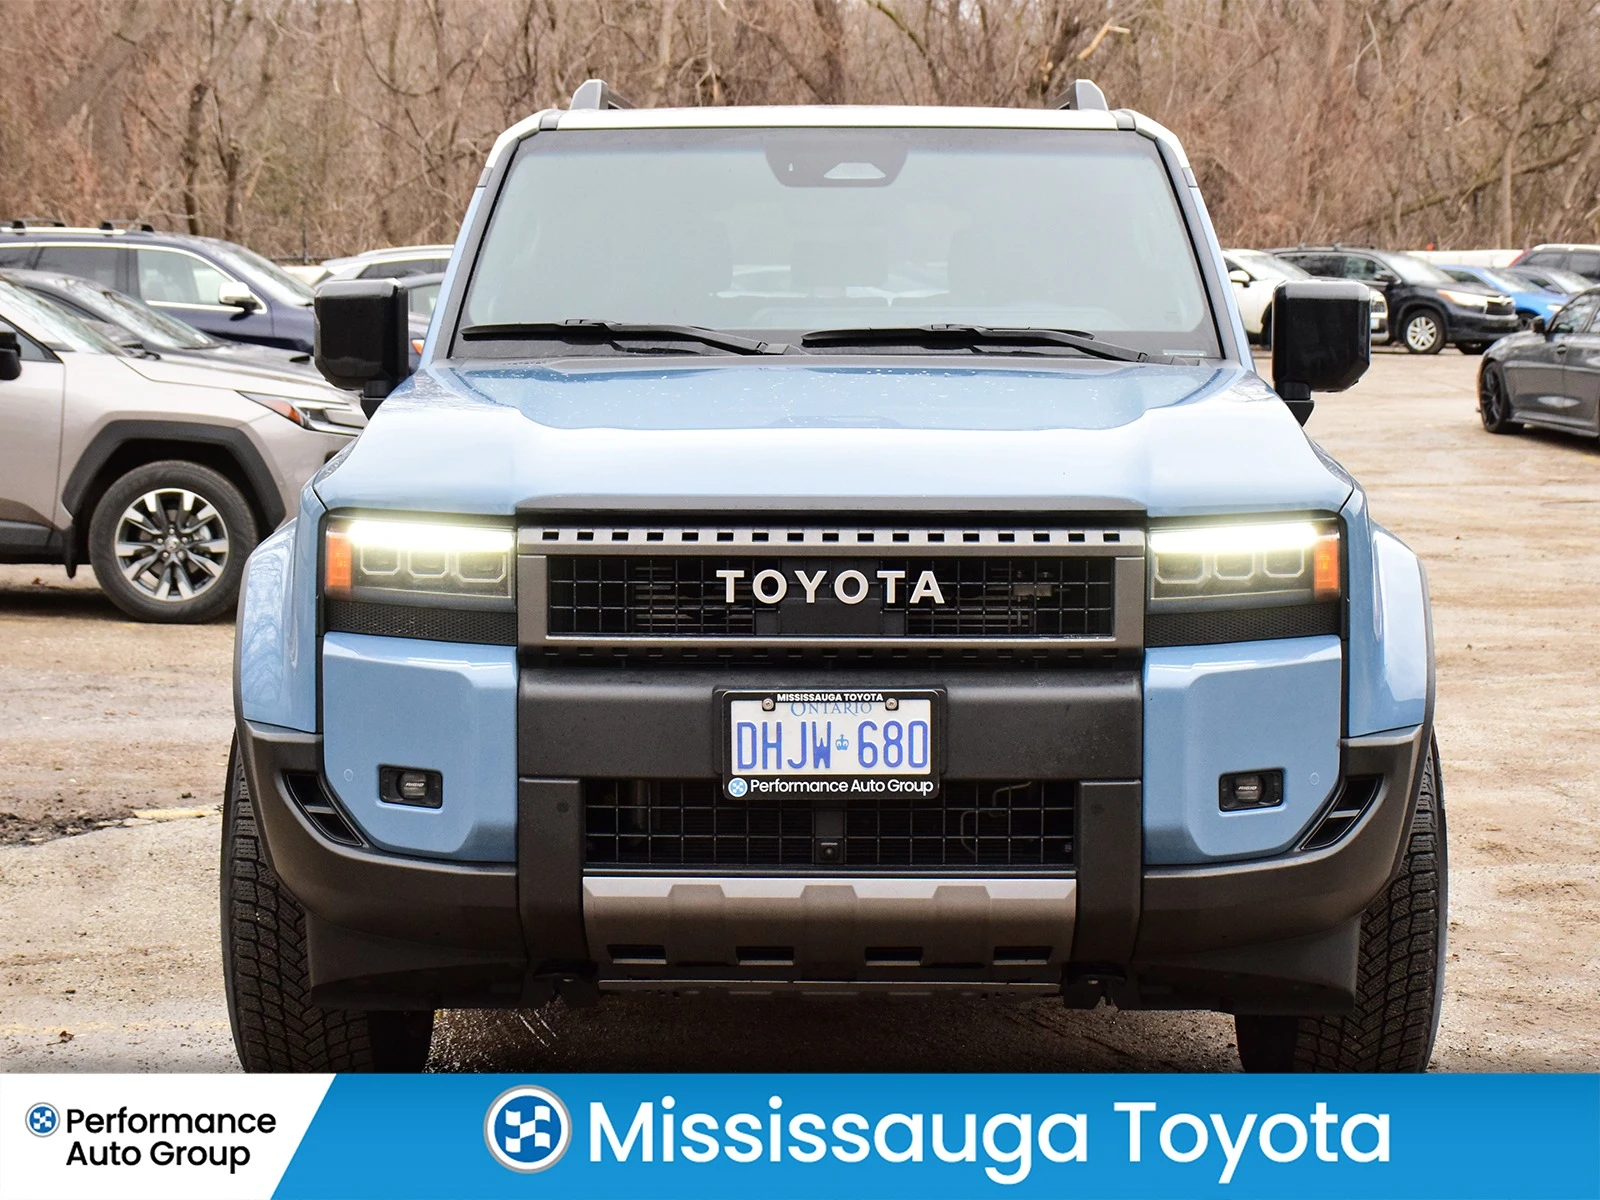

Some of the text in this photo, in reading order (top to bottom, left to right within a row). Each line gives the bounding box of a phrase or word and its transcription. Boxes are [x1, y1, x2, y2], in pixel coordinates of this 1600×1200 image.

[716, 569, 945, 604] TOYOTA
[776, 693, 884, 702] MISSISSAUGA TOYOTA
[790, 702, 873, 716] ONTARIO
[737, 720, 928, 769] DHJW 680
[750, 778, 934, 797] Performance Auto Group
